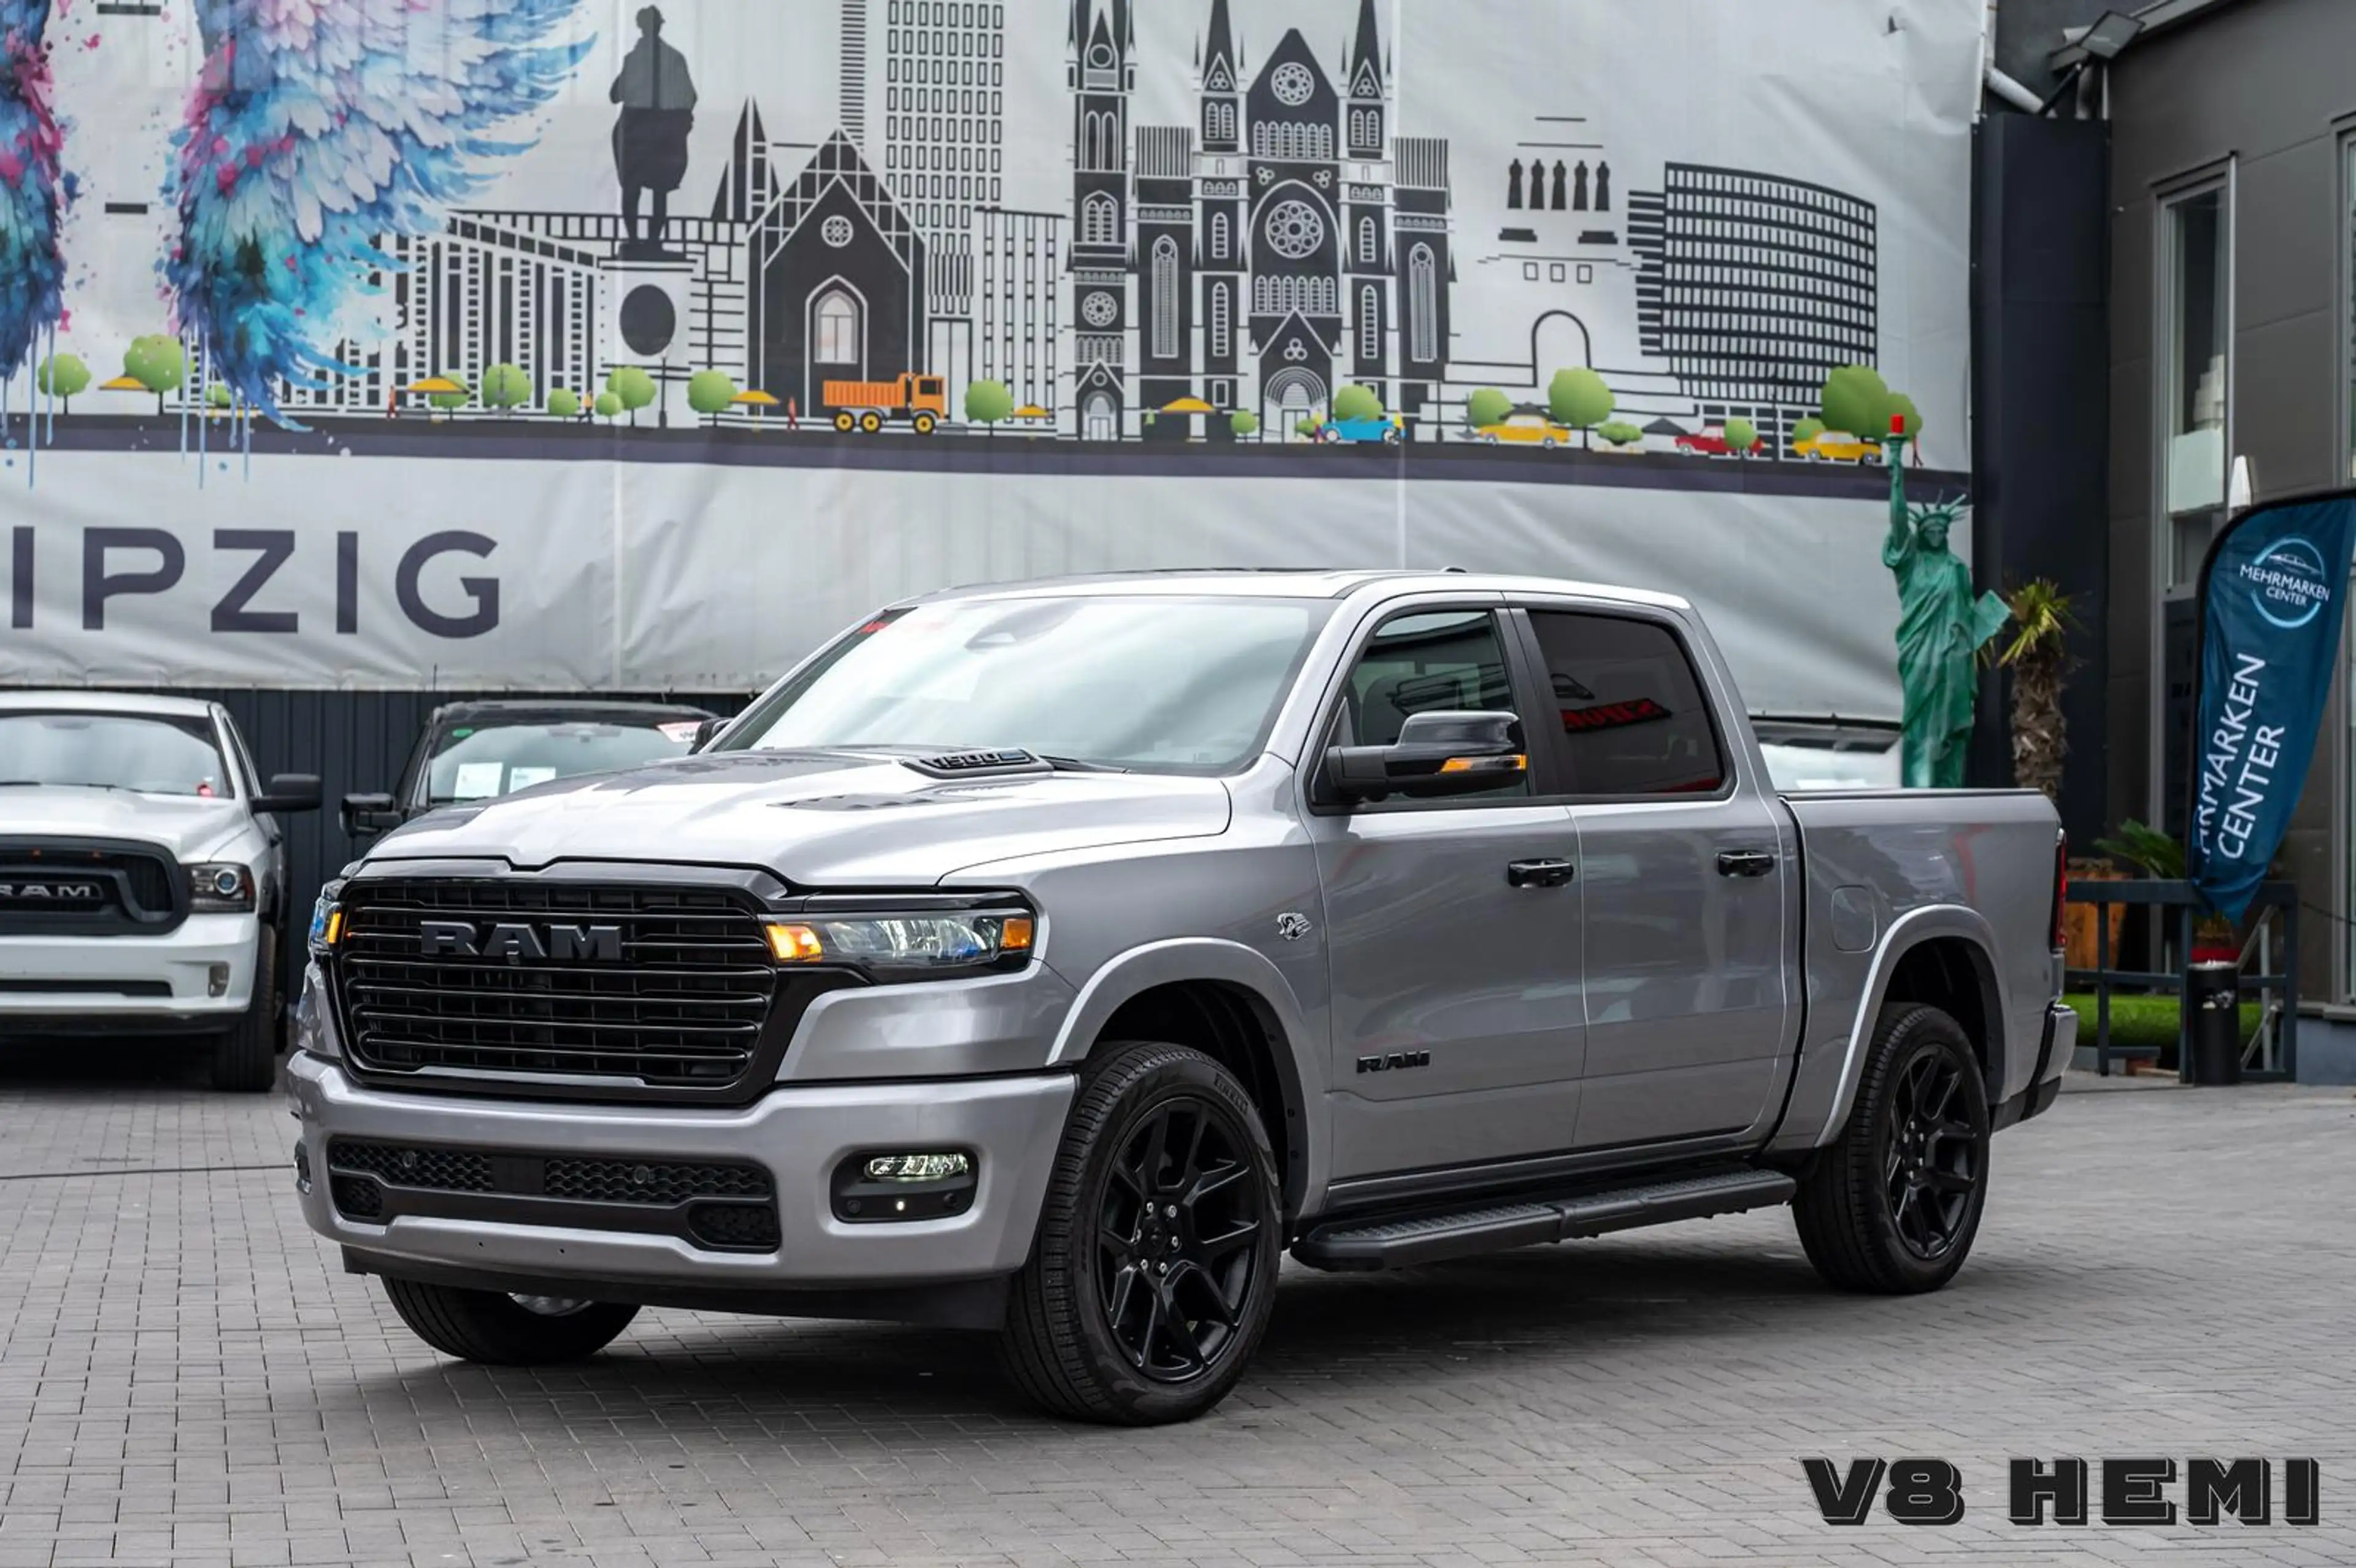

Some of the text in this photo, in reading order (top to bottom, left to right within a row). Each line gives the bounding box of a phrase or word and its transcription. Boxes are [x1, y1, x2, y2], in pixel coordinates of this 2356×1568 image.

[2239, 562, 2331, 602] MEHRMARKEN
[2265, 585, 2308, 608] CENTER
[2217, 724, 2286, 859] CENTER
[420, 920, 623, 960] RAM
[1356, 1049, 1431, 1074] RAM
